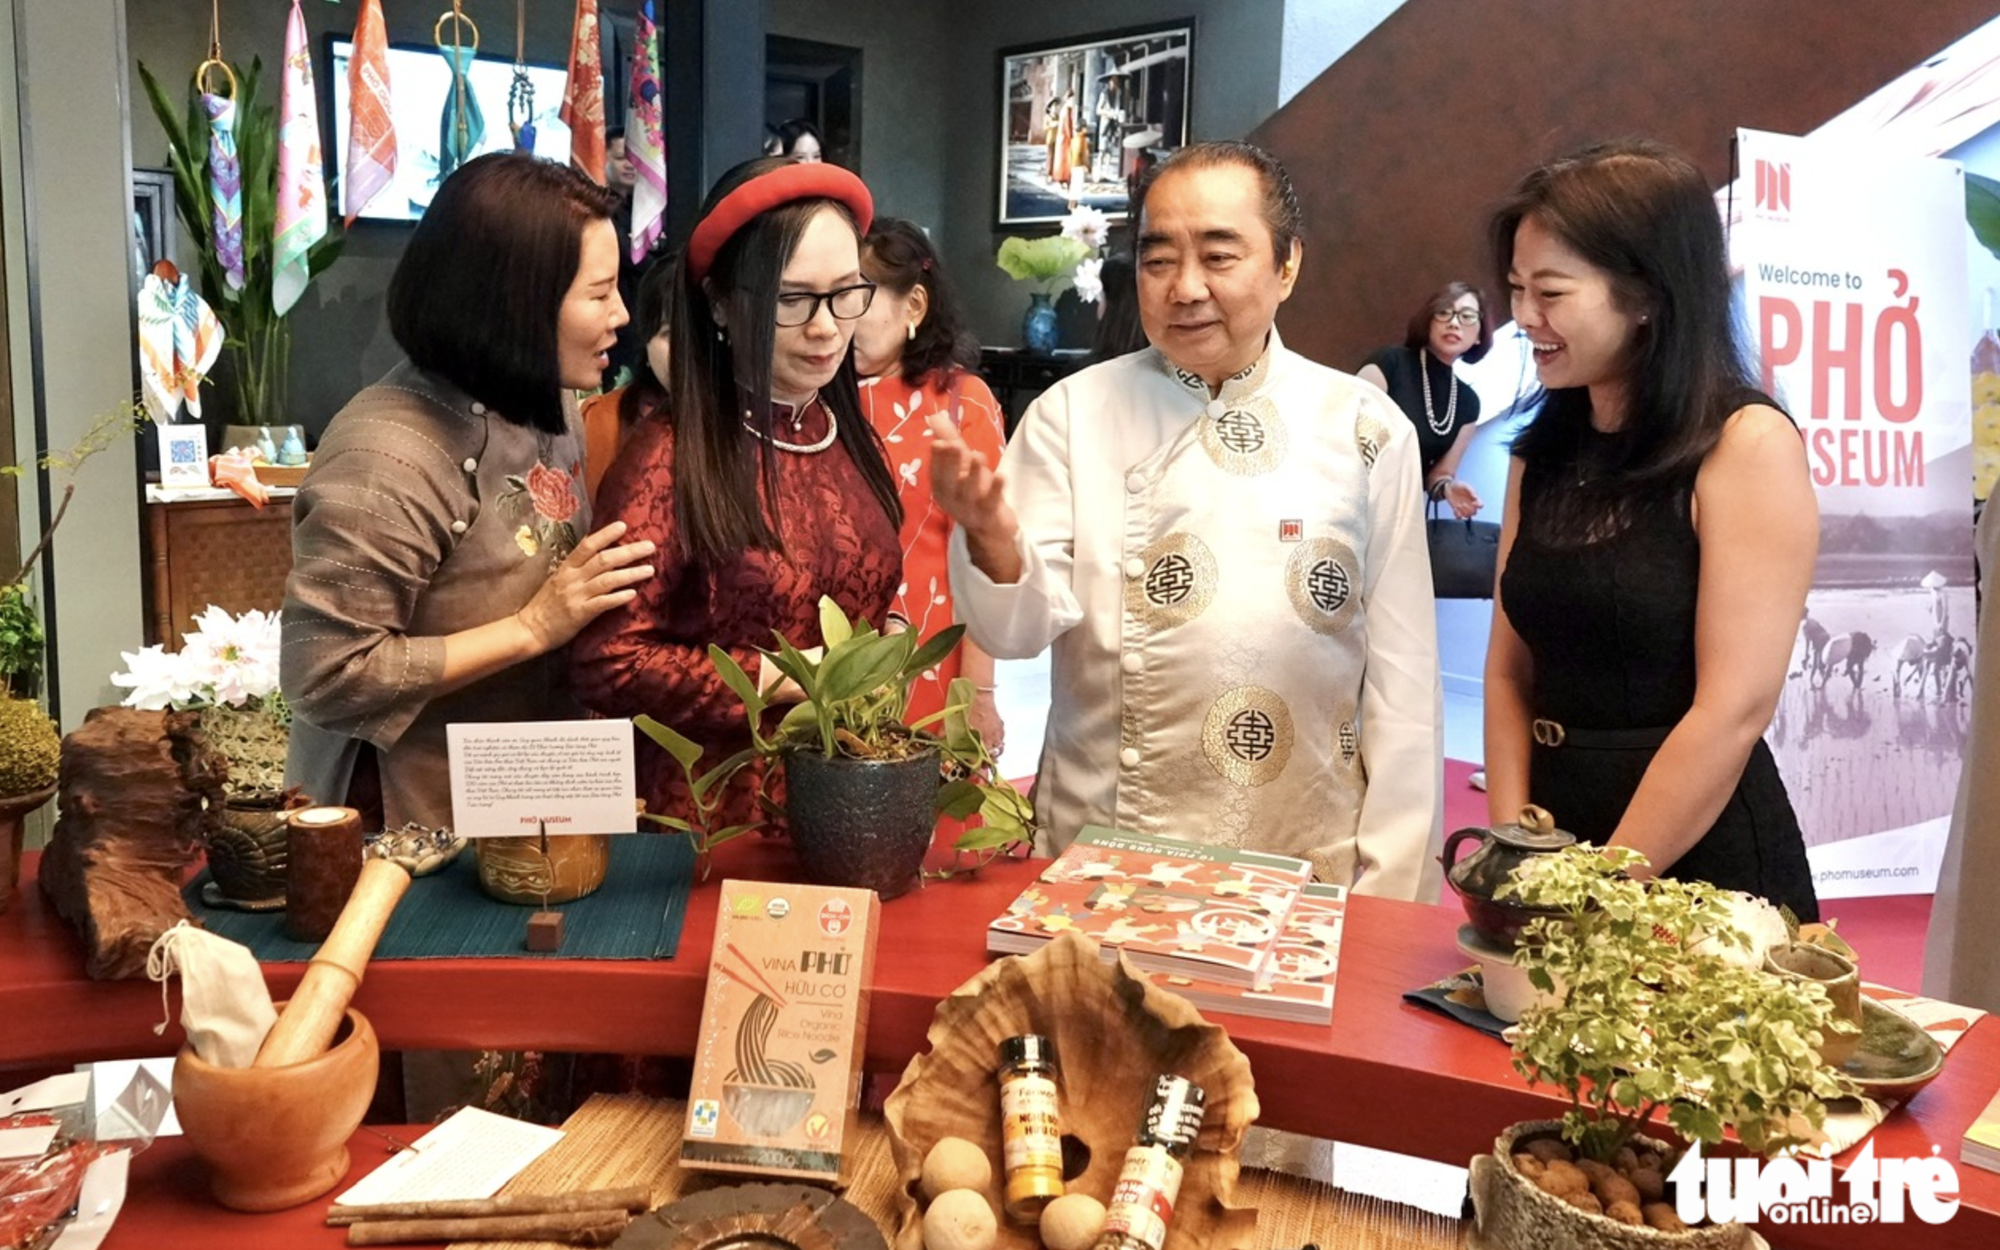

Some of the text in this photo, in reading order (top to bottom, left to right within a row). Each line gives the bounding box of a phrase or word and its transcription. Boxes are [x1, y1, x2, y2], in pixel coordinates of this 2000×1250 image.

[1758, 263, 1863, 290] Welcome to
[1758, 268, 1923, 423] PHỞ
[1799, 427, 1924, 488] SEUM
[762, 957, 797, 972] VINA
[820, 983, 847, 999] CƠ
[821, 1009, 843, 1020] Vina
[800, 1019, 841, 1032] Organic
